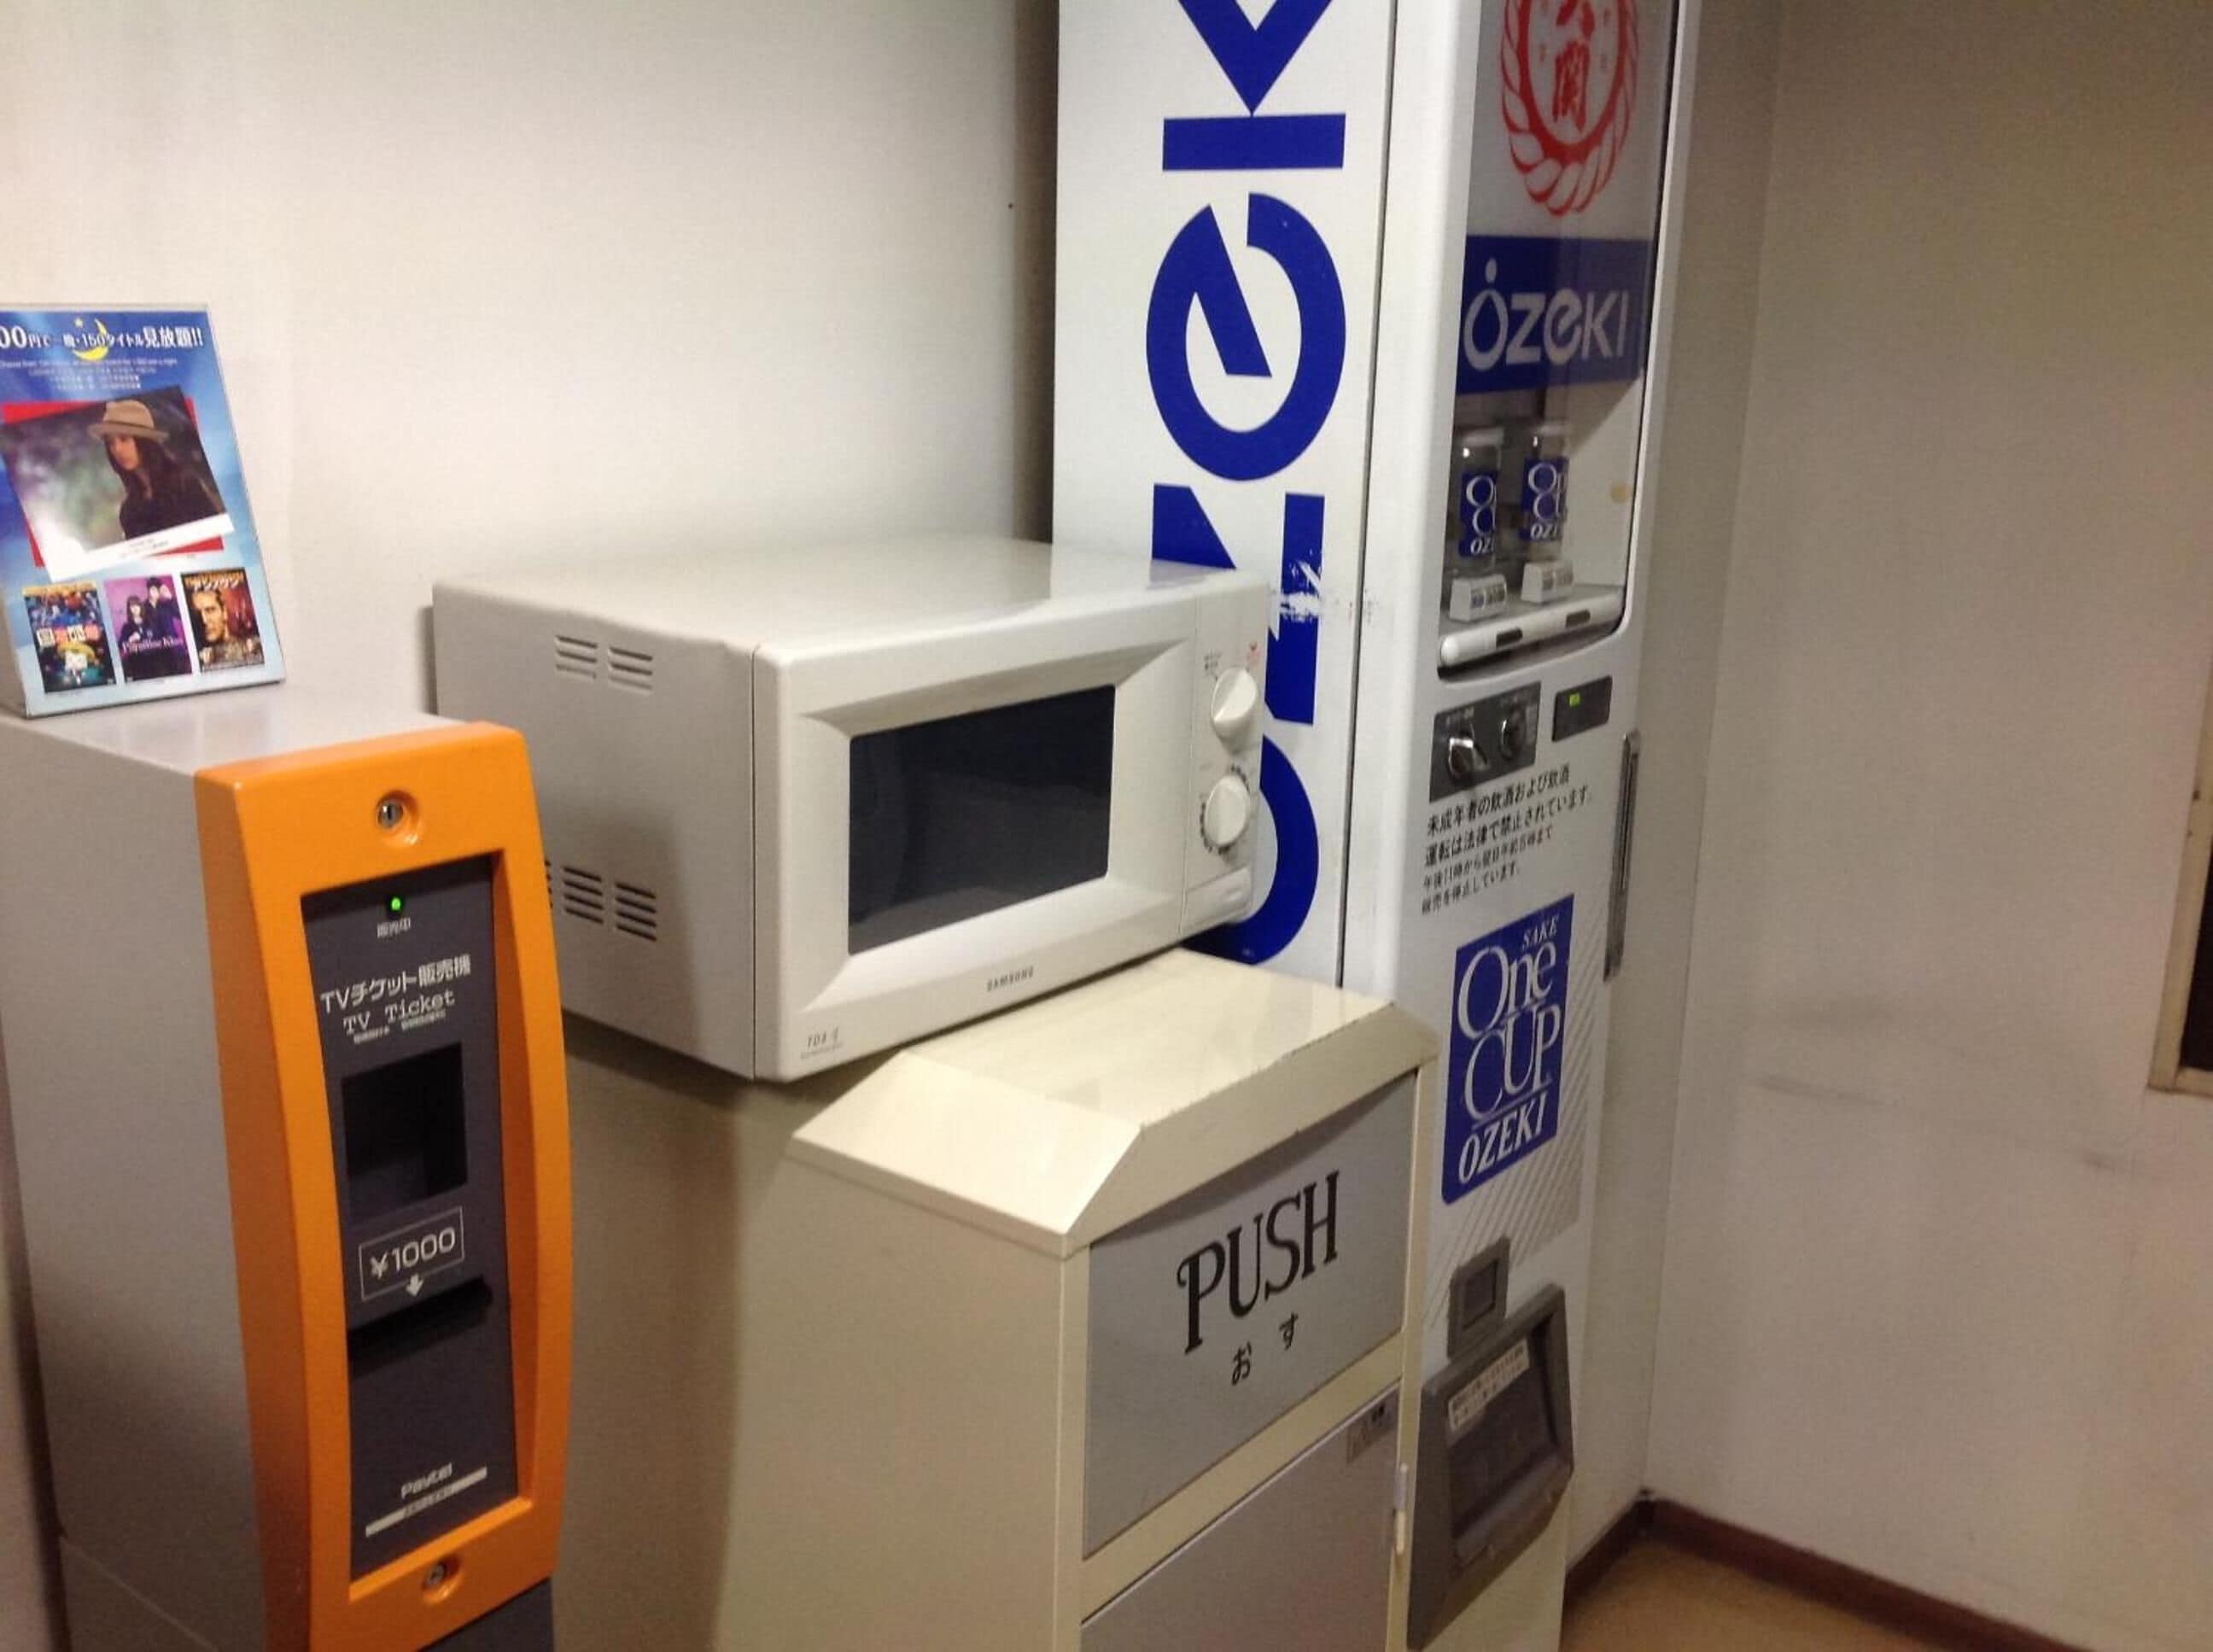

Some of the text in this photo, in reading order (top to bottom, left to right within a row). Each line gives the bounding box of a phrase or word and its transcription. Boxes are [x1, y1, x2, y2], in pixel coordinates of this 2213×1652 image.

[1522, 914, 1560, 950] SAKE
[320, 954, 471, 1014] TVチケット販売機
[343, 1011, 371, 1036] TV
[384, 989, 455, 1023] Ticket
[1458, 942, 1557, 1040] One
[1464, 1002, 1562, 1120] CUP
[1458, 1090, 1548, 1185] OZEKI
[370, 1227, 456, 1279] ¥1000
[1177, 1170, 1340, 1355] PUSH
